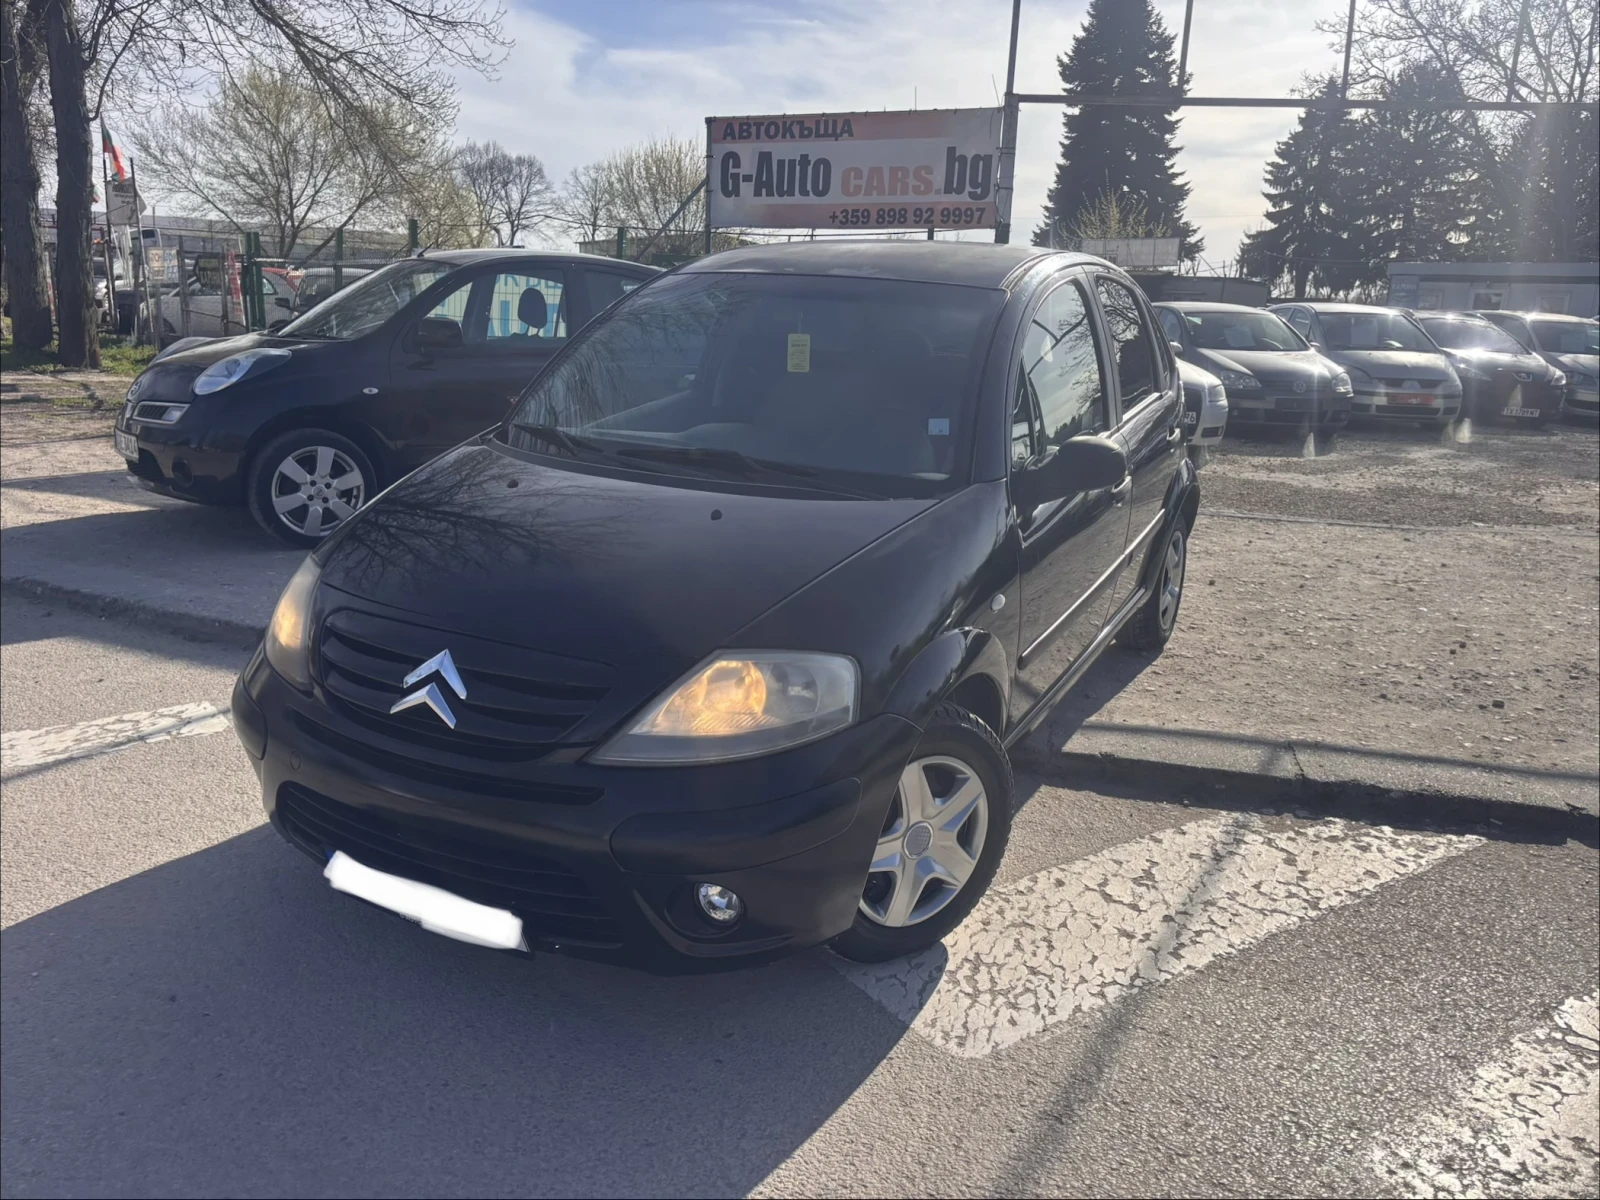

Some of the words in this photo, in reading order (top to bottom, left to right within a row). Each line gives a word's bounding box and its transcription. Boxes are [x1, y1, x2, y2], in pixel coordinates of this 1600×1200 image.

[722, 119, 854, 141] АВТОКЪЩА
[720, 151, 832, 198] G-Auto
[841, 146, 993, 201] CARS.bg
[829, 208, 871, 226] +359
[875, 208, 908, 225] 898
[913, 207, 935, 225] 92
[940, 207, 986, 225] 9997
